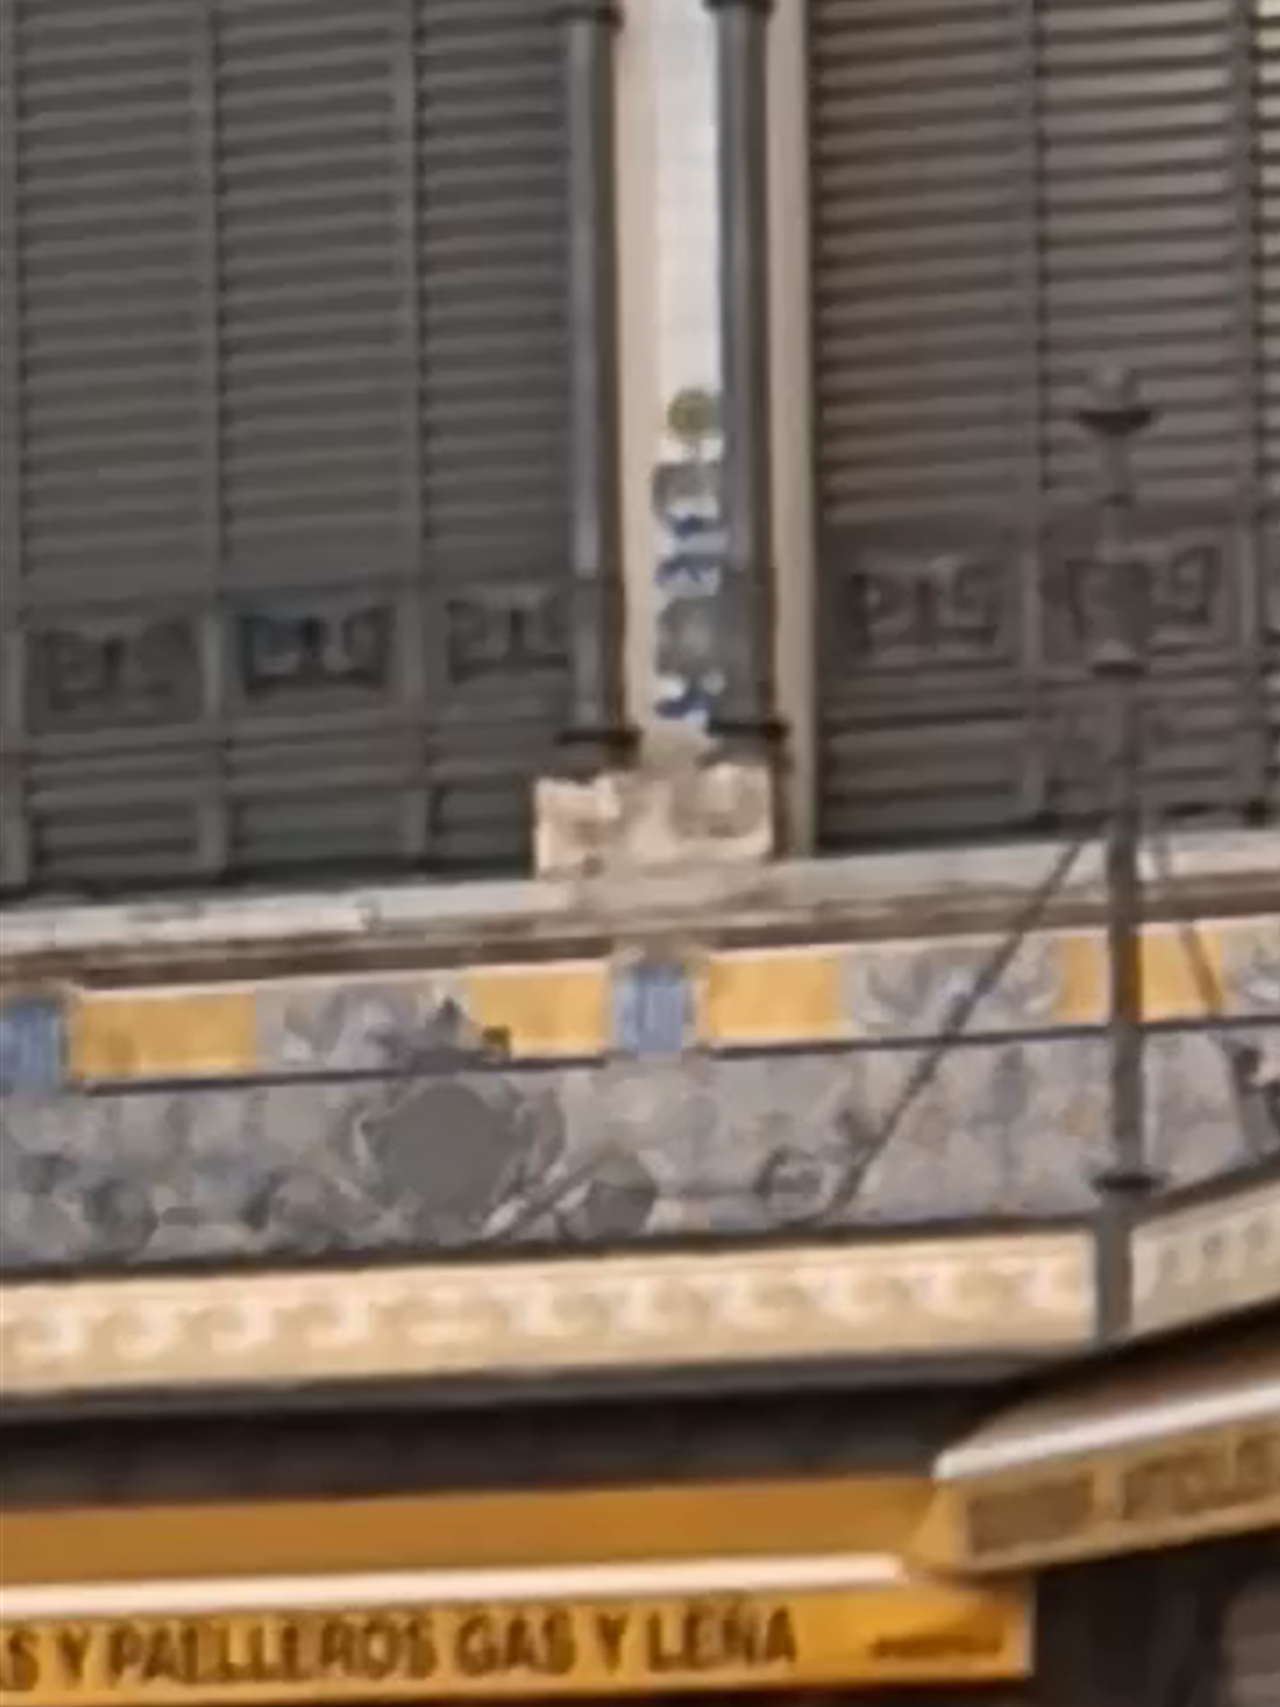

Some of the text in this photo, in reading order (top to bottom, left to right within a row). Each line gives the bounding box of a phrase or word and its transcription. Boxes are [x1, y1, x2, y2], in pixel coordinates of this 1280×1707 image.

[55, 1625, 90, 1690] Y
[454, 1605, 577, 1677] GAS
[595, 1603, 631, 1675] Y
